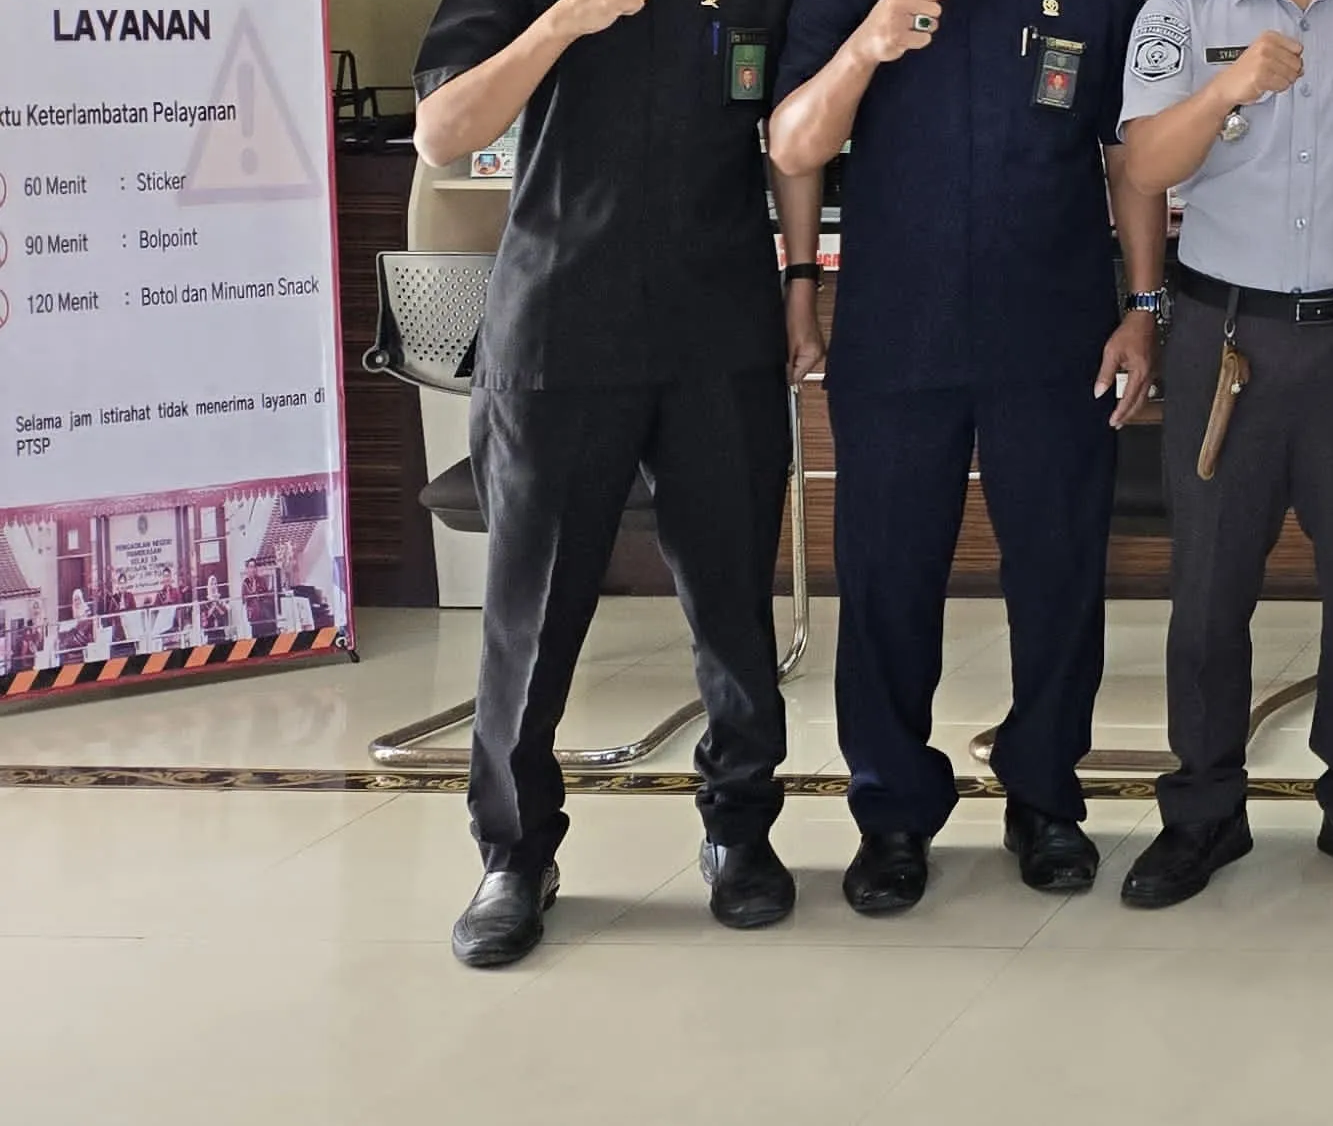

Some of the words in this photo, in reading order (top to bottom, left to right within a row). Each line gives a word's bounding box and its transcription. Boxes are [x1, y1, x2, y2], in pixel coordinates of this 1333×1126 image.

[53, 9, 211, 42] LAYANAN
[27, 103, 148, 128] Keterlambatan
[153, 100, 237, 131] Pelayanan
[24, 177, 42, 196] 60
[46, 176, 87, 195] Menit
[137, 172, 187, 193] Sticker
[25, 236, 43, 256] 90
[47, 234, 89, 253] Menit
[139, 228, 199, 253] Bolpoint
[28, 293, 54, 314] 120
[58, 291, 99, 312] Menit
[142, 286, 178, 307] Botol
[182, 283, 208, 304] dan
[212, 280, 275, 302] Minuman
[278, 275, 320, 297] Snack
[16, 413, 62, 432] Selama
[69, 411, 92, 432] jam
[158, 399, 189, 419] tidak
[196, 396, 255, 415] menerima
[261, 391, 307, 414] layanan
[314, 388, 326, 405] di
[16, 437, 51, 457] PTSP
